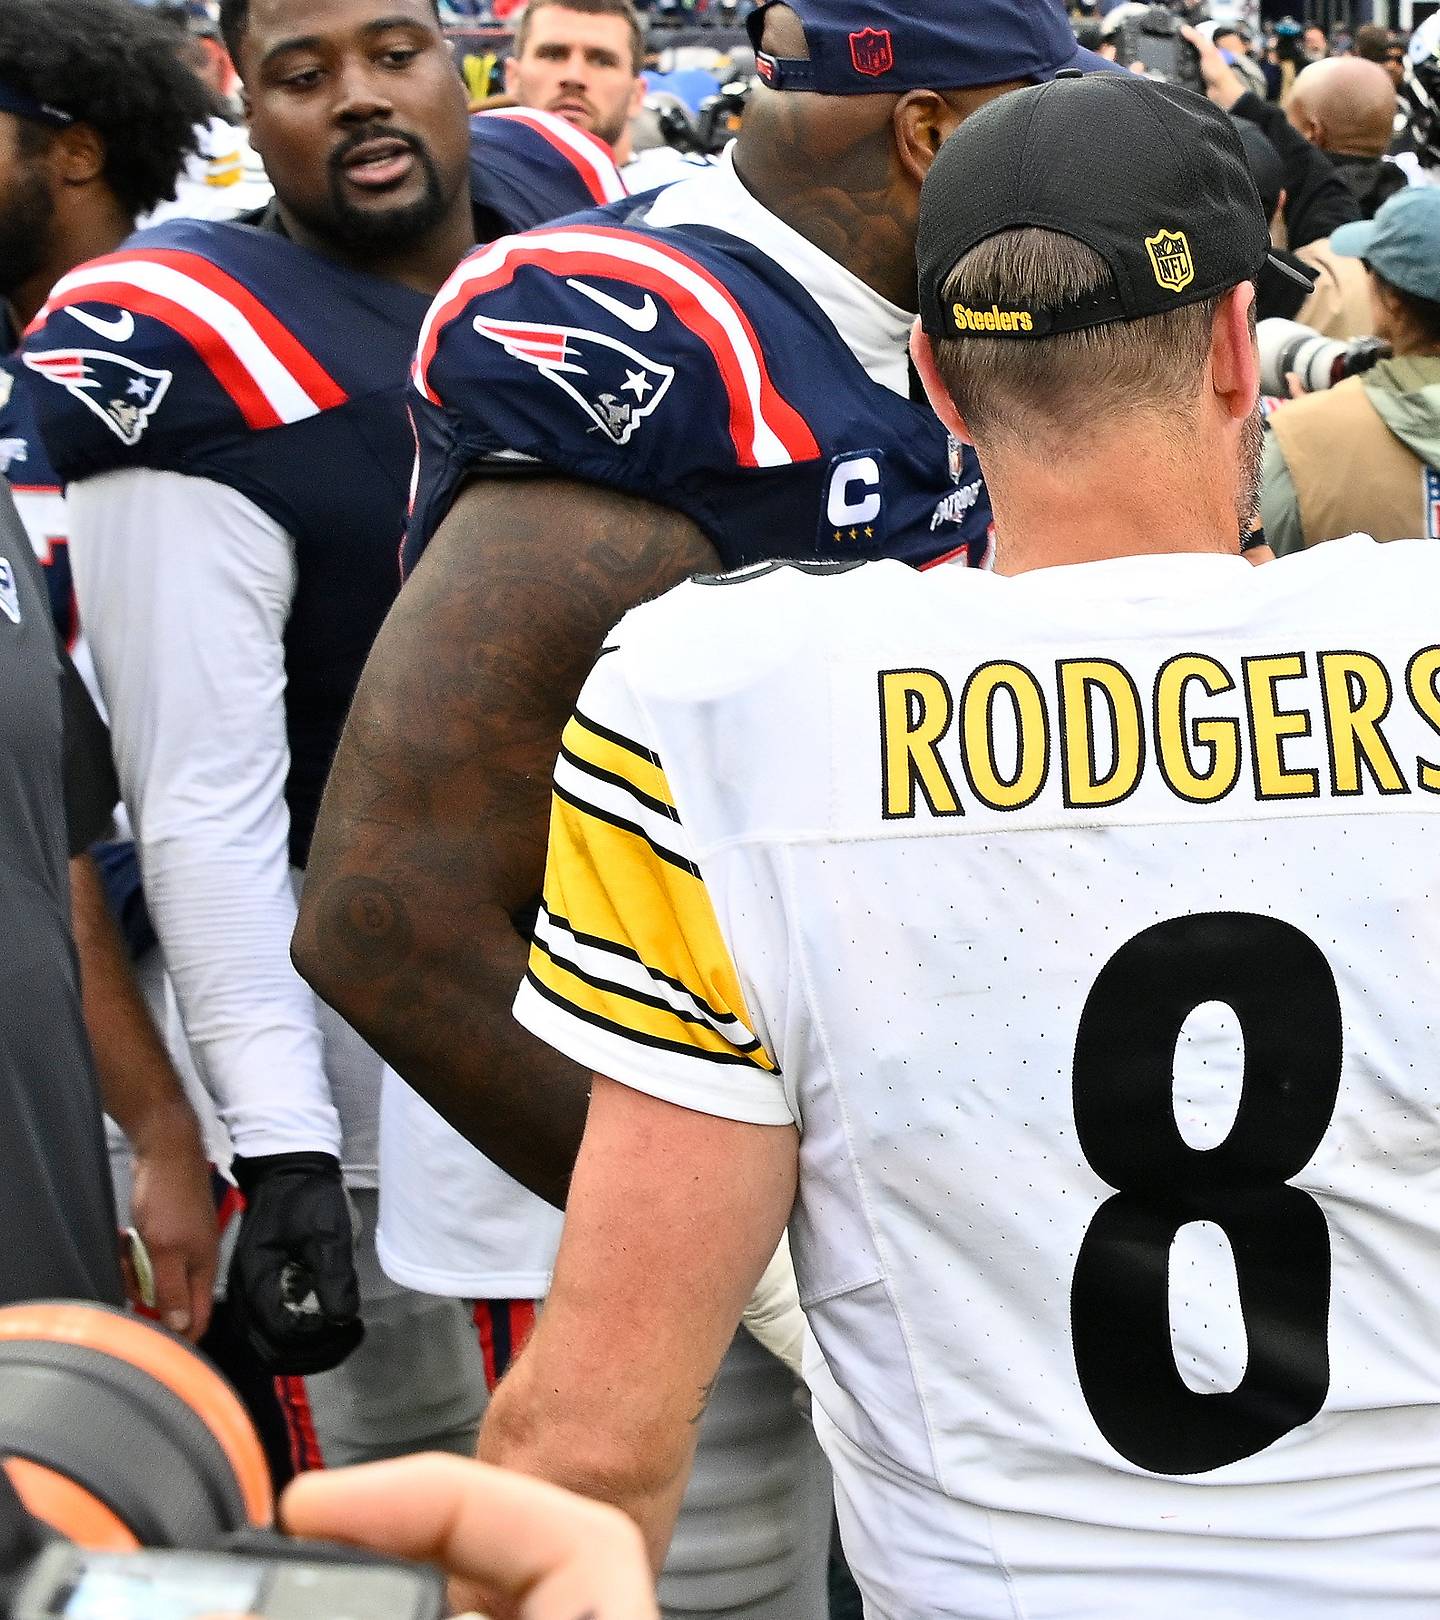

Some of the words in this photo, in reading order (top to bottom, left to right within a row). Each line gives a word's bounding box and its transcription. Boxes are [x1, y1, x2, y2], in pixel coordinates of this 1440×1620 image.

[1158, 256, 1188, 283] NFL
[953, 303, 1034, 331] Steelers
[827, 457, 881, 527] C
[1070, 911, 1343, 1475] 8
